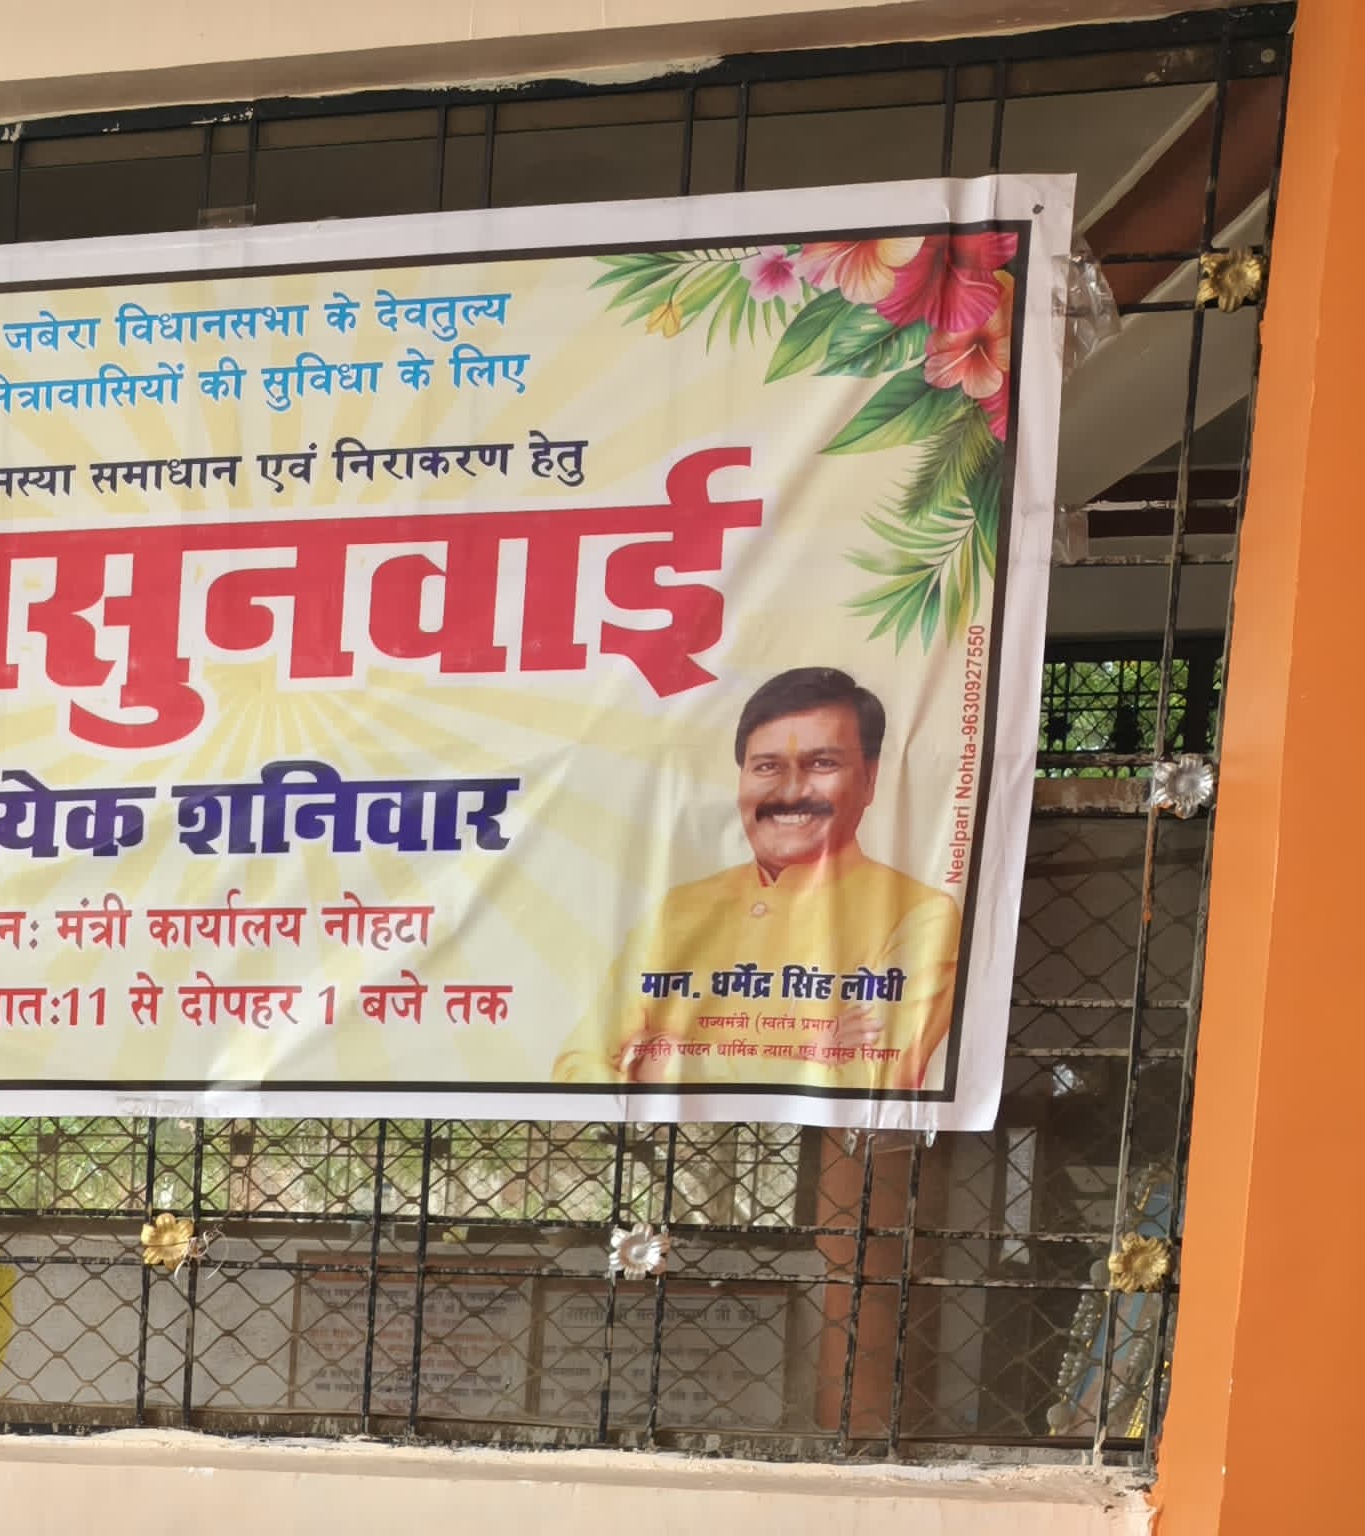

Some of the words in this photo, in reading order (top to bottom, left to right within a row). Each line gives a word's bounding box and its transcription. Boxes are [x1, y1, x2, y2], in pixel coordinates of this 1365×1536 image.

[3, 311, 100, 352] जबेरा
[115, 304, 309, 346] विधानसभा
[324, 293, 360, 333] के
[375, 291, 512, 342] देवतुल्य
[198, 357, 247, 400] की
[261, 353, 383, 412] सुविधा
[397, 349, 434, 390] के
[451, 347, 531, 393] लिए
[90, 456, 242, 493] समाधान
[257, 443, 317, 492] एवं
[332, 438, 514, 482] निराकरण
[529, 431, 588, 486] हेतु
[172, 761, 520, 854] शनिवार
[945, 806, 971, 884] Neelpari
[56, 892, 131, 950] मंत्री
[146, 888, 307, 948] कार्यालय
[322, 891, 434, 950] नोहटा
[129, 971, 164, 1027] से
[178, 971, 301, 1030] दोपहर
[317, 987, 335, 1026] 1
[360, 969, 429, 1026] बजे
[444, 985, 513, 1027] तक
[641, 971, 701, 998] मान.
[781, 965, 836, 998] सिंह
[840, 967, 907, 1002] लोधी
